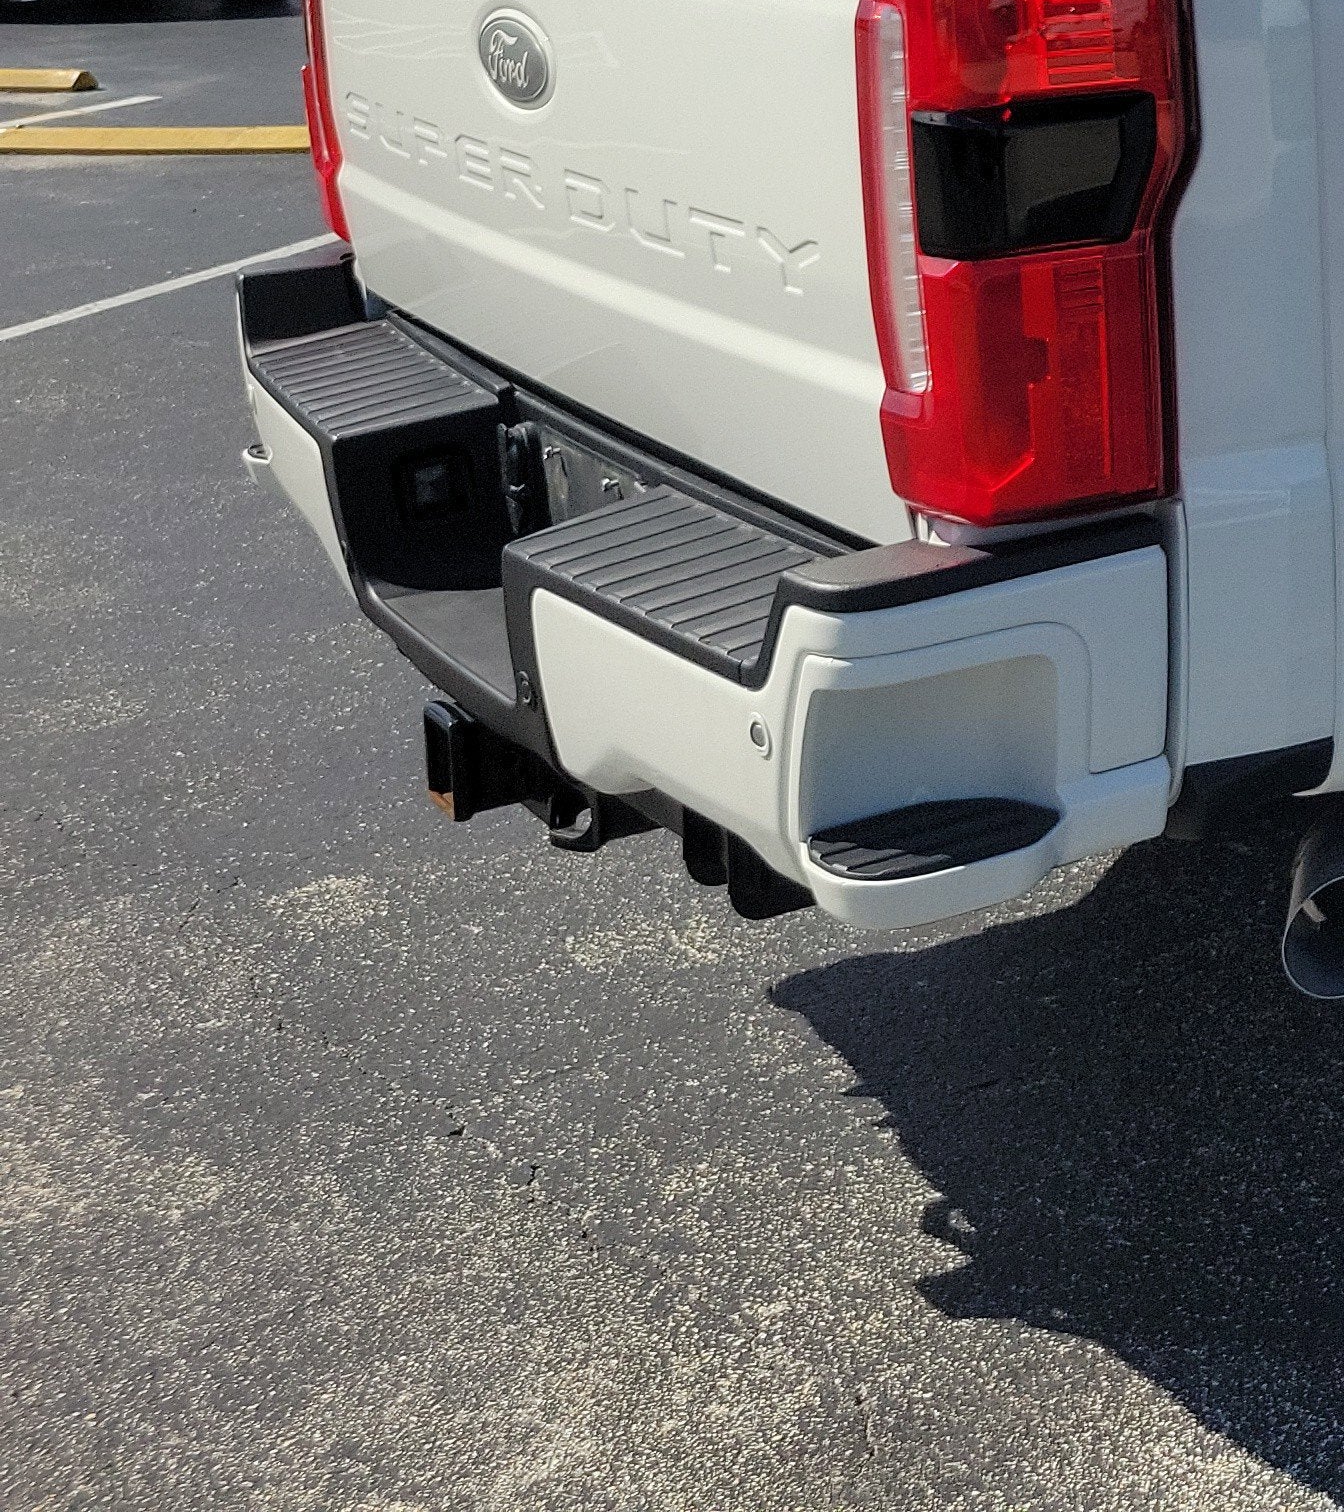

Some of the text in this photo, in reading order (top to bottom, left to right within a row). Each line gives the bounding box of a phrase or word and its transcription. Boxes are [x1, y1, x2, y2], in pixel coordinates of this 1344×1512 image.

[487, 28, 530, 89] Ford
[344, 91, 821, 296] SUPER DUTY
